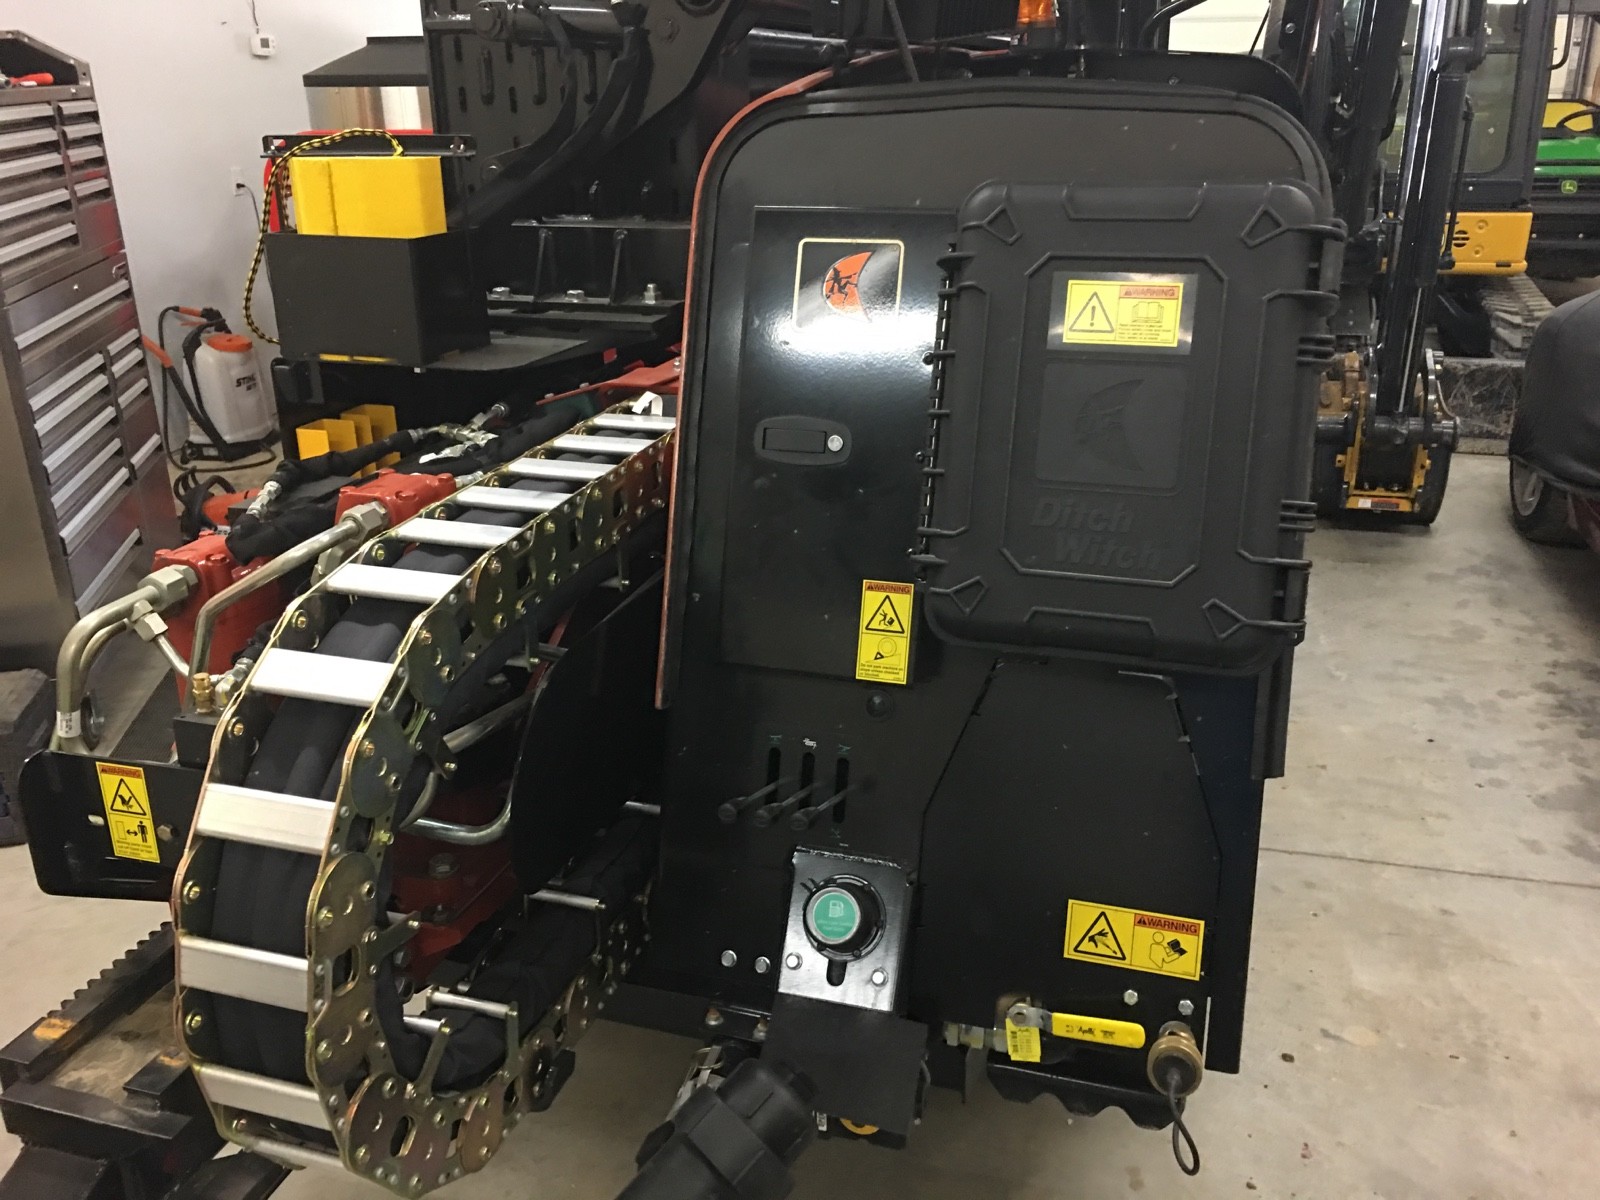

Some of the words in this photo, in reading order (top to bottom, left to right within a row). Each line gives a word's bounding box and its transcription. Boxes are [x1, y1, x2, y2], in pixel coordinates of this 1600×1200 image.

[1131, 288, 1175, 297] WARNING
[1029, 494, 1135, 532] Ditch
[1053, 529, 1162, 570] Witch
[874, 583, 910, 593] WARNING
[1147, 917, 1197, 933] WARNING
